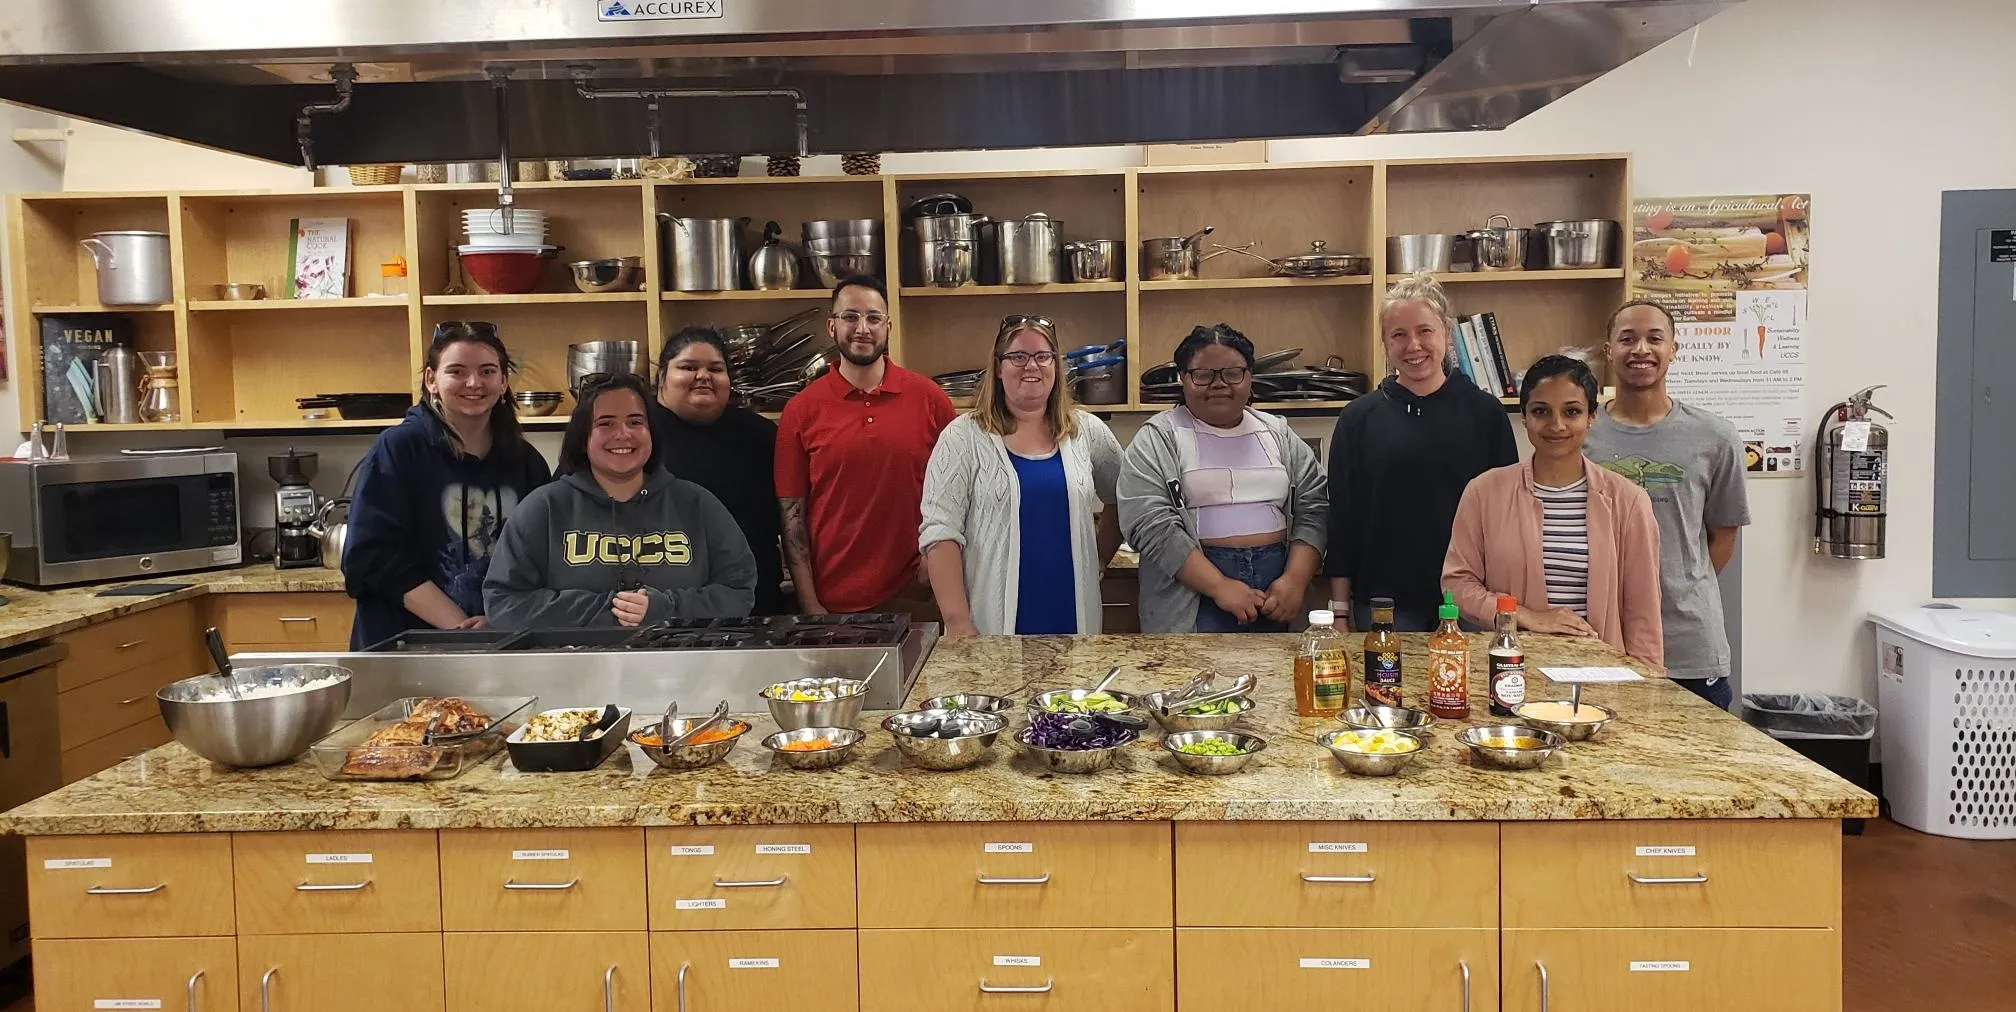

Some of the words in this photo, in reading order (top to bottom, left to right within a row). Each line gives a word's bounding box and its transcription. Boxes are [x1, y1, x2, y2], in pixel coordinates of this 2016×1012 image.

[634, 1, 718, 15] ACCUREX
[1665, 202, 1676, 212] is
[1679, 204, 1696, 212] an
[1698, 198, 1782, 216] Agricultural
[64, 329, 113, 343] VEGAN
[1694, 327, 1732, 336] DOOR
[1679, 342, 1713, 350] OCALLY
[1718, 341, 1731, 349] BY
[1691, 354, 1724, 362] KNOW.
[563, 530, 692, 566] UCCS
[1376, 671, 1399, 679] HOISIN
